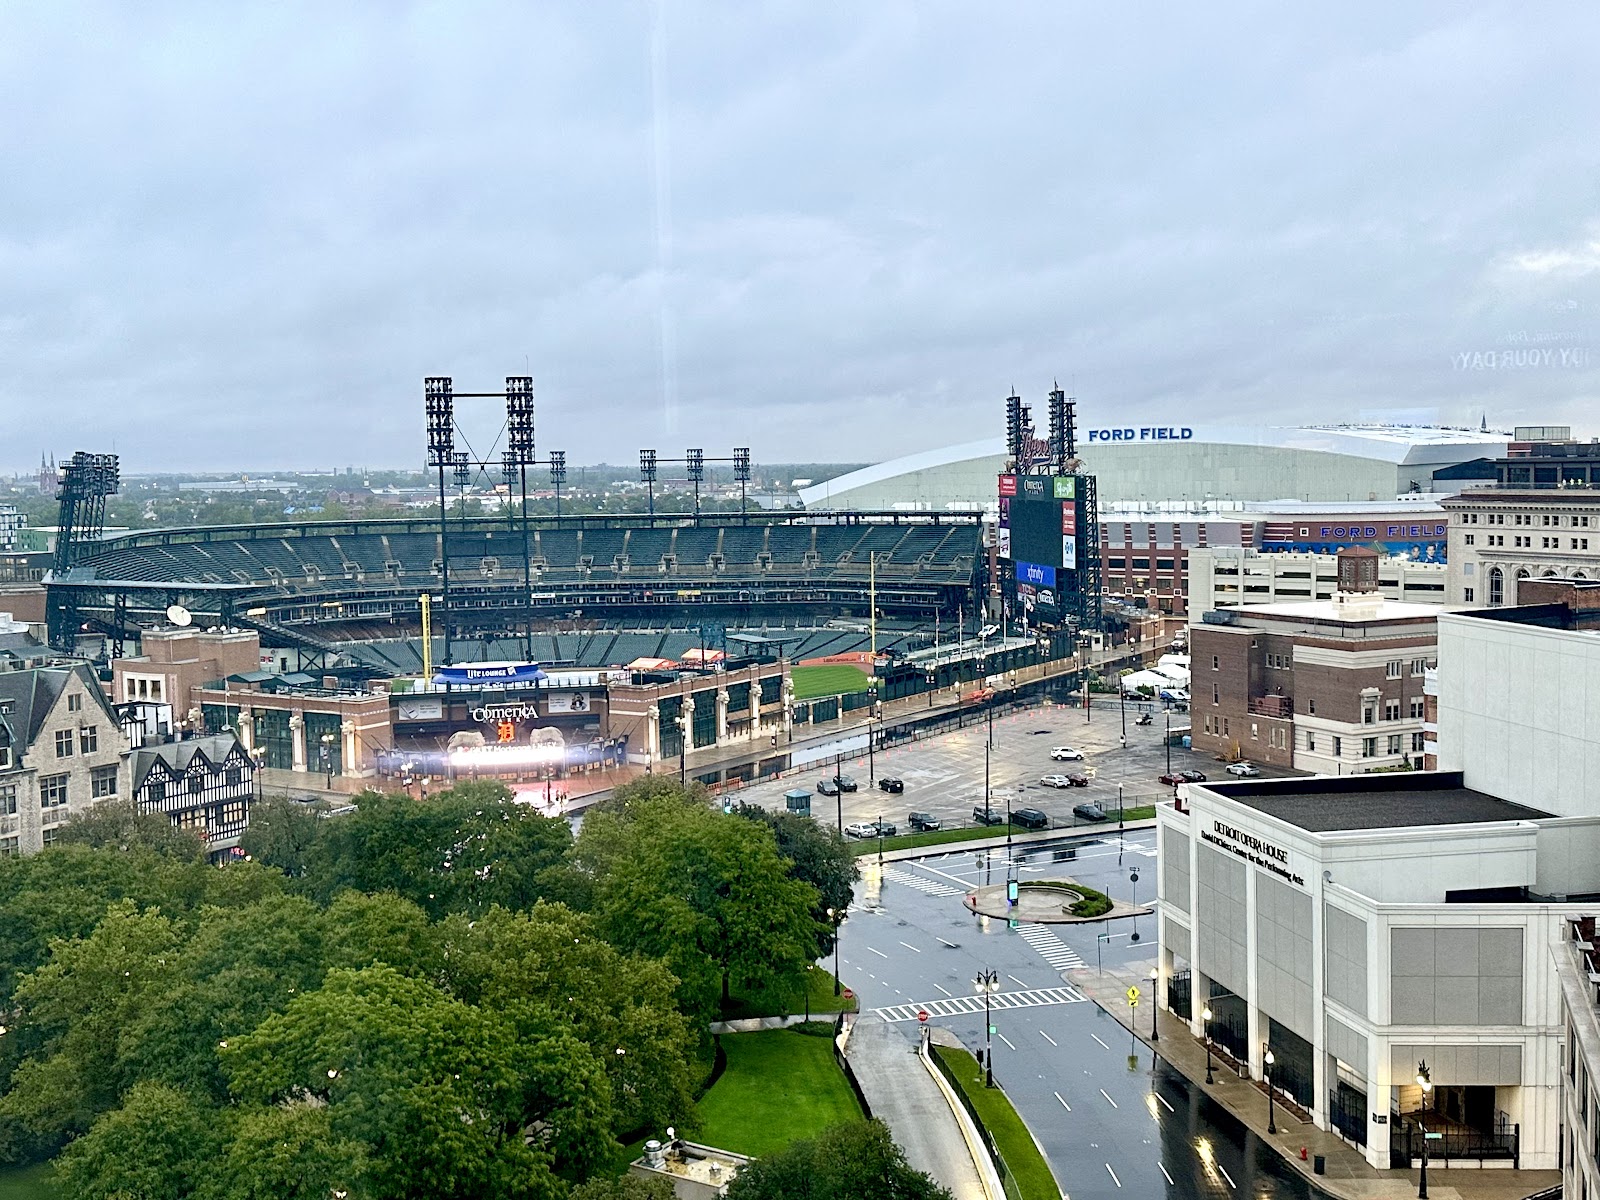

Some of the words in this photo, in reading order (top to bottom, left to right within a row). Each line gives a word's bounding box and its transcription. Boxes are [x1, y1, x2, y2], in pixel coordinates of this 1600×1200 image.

[1089, 428, 1136, 442] FORD
[1140, 426, 1193, 440] FIELD
[1320, 525, 1377, 538] FORD
[1387, 524, 1447, 538] FIELD
[482, 669, 507, 678] LOUNGE
[1214, 820, 1241, 842] DETROIT
[1240, 832, 1263, 854] OPERA
[1262, 841, 1288, 864] HOUSE
